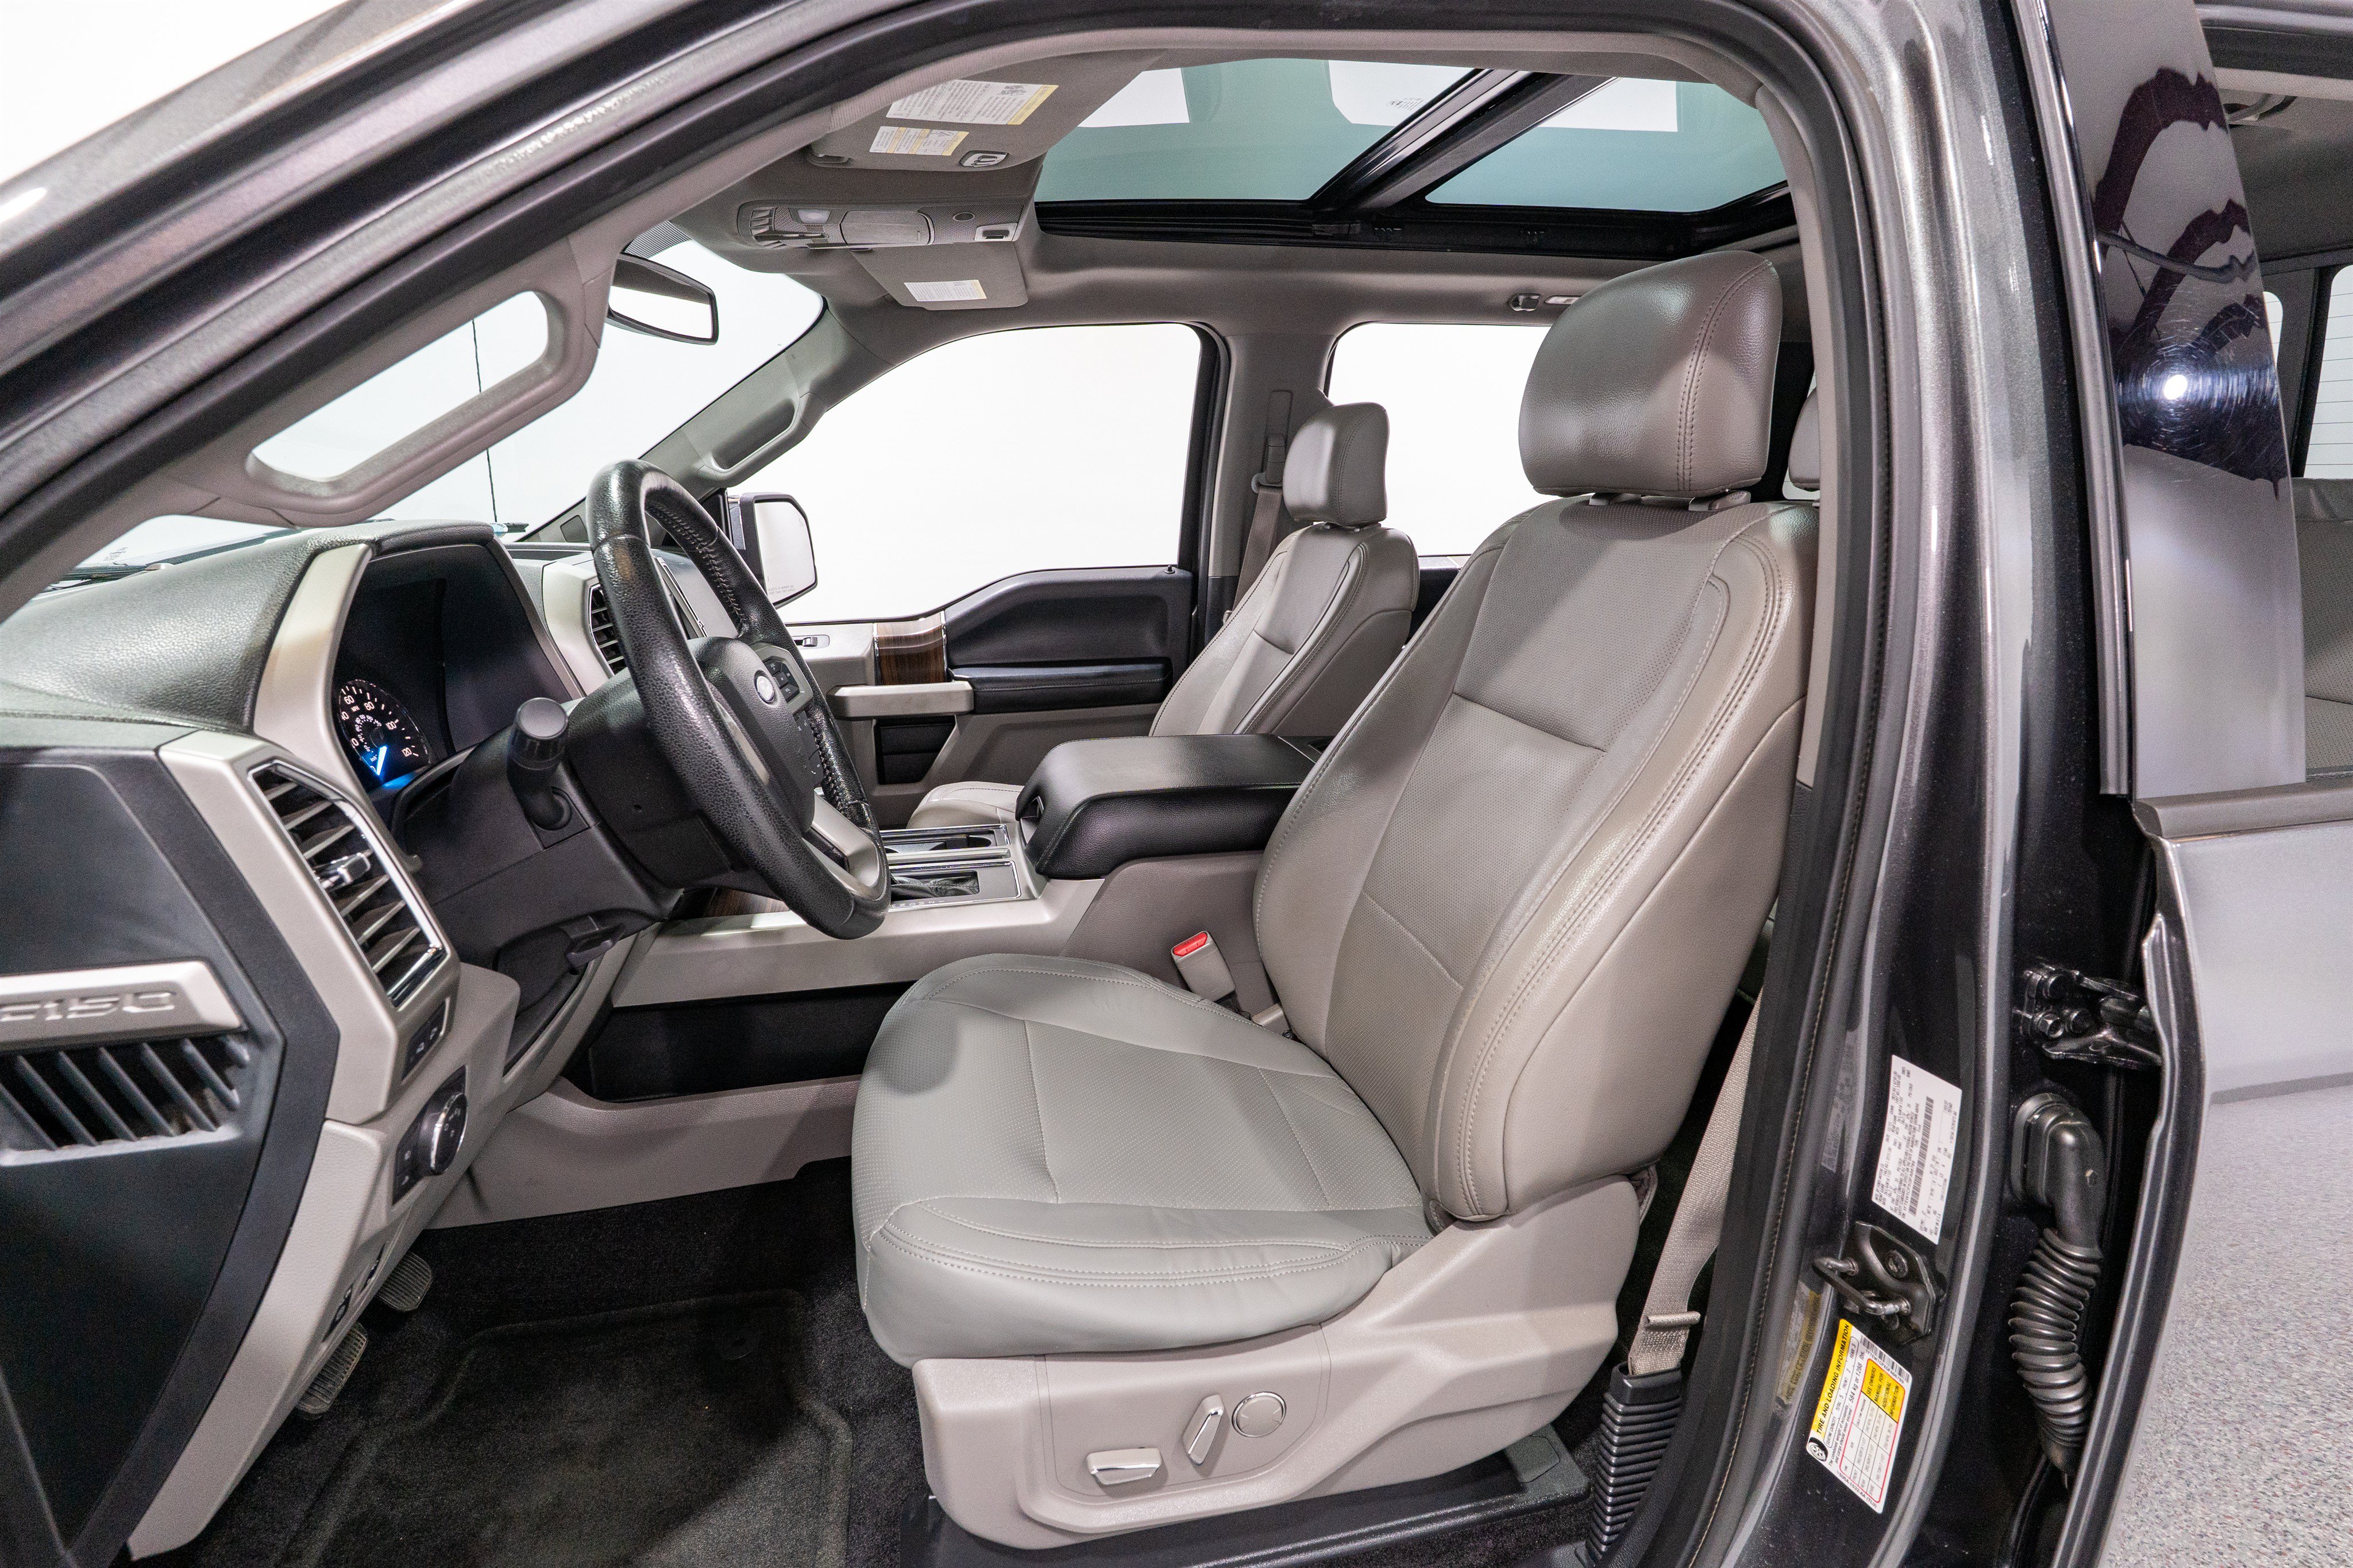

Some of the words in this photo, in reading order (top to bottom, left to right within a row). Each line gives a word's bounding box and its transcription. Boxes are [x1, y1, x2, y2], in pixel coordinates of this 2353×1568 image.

[344, 696, 354, 704] 60
[364, 701, 375, 710] 80
[385, 721, 396, 730] 100
[402, 747, 412, 757] 120
[1816, 1417, 1824, 1436] TIRE
[1821, 1401, 1829, 1419] AND
[1826, 1370, 1839, 1404] LOADING
[1834, 1323, 1851, 1372] INFORMATION
[1854, 1376, 1859, 1384] or
[1868, 1365, 1877, 1387] OWNERS
[1851, 1382, 1858, 1392] kg
[1873, 1382, 1882, 1403] MANUAL
[1881, 1380, 1891, 1409] ADDITIONAL
[1888, 1384, 1900, 1417] INFORMATION
[1830, 1440, 1838, 1460] combined
[1840, 1403, 1849, 1426] occupants
